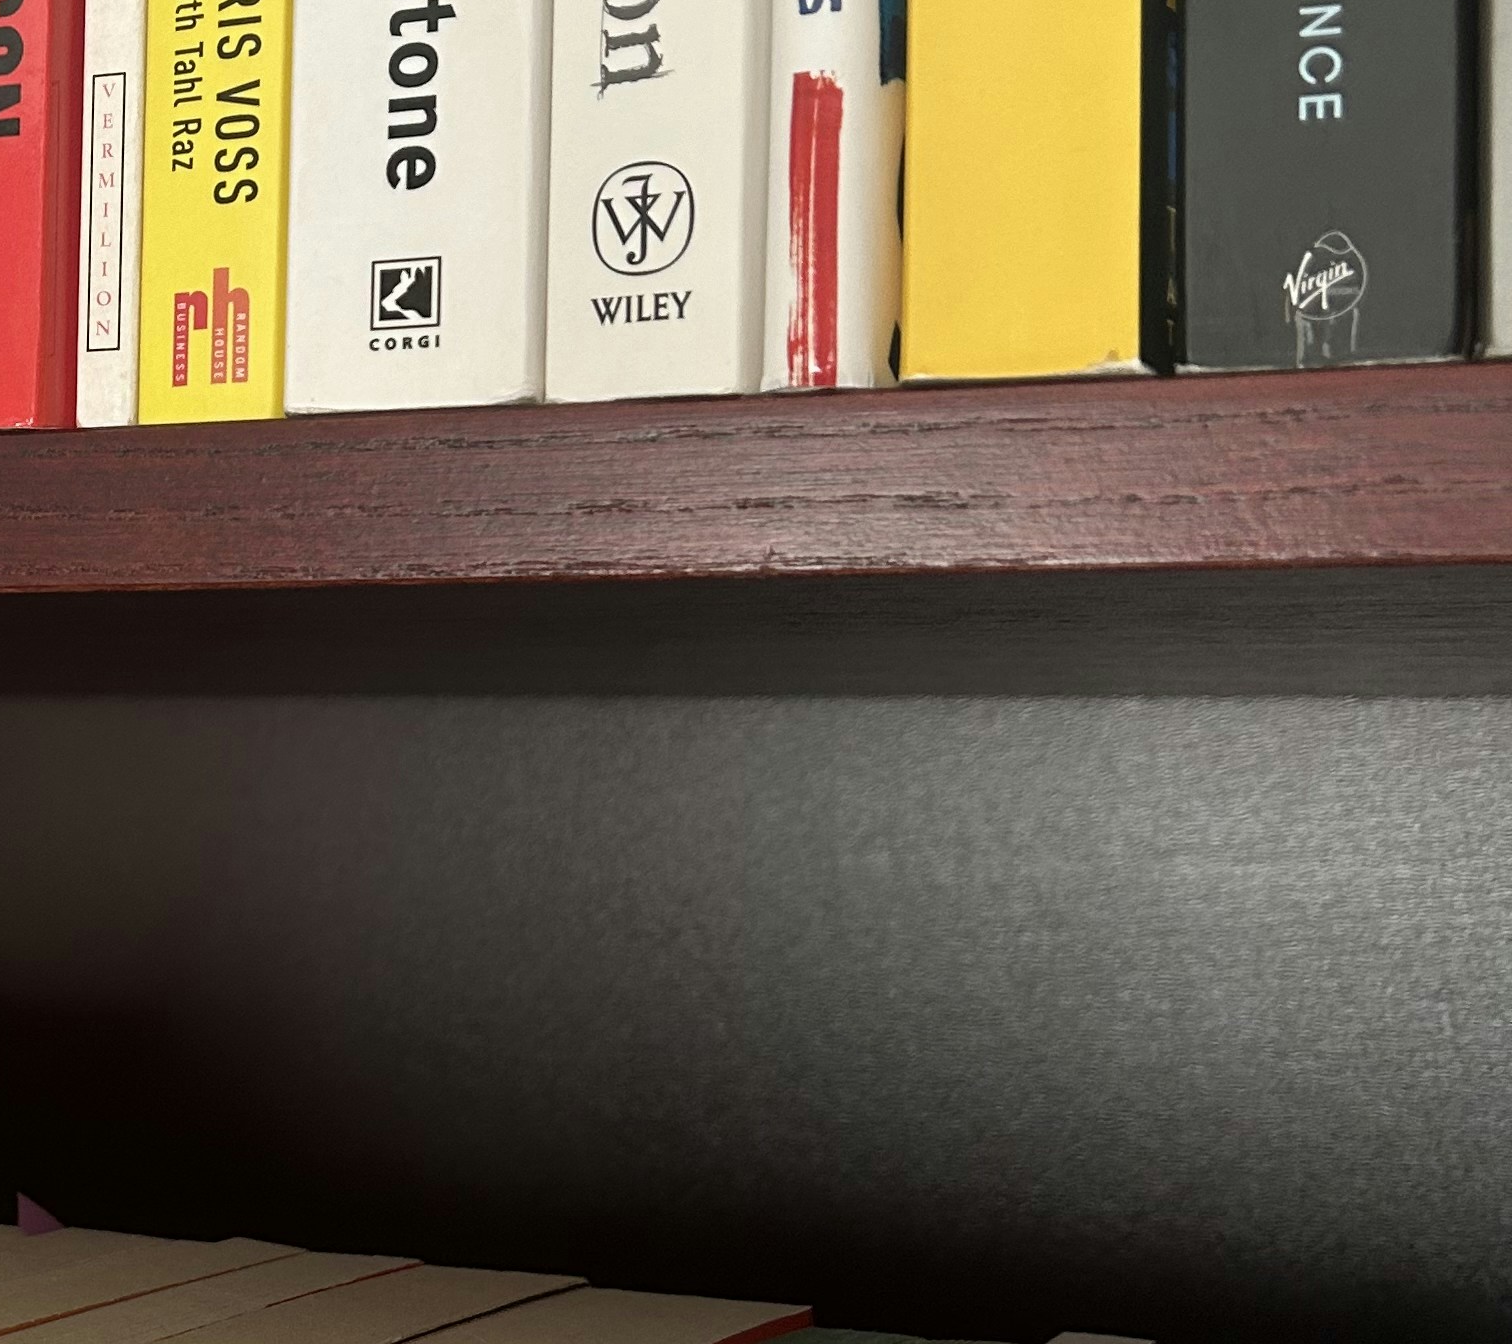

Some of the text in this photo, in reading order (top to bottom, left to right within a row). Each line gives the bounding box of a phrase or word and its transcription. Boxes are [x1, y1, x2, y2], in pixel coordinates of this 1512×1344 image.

[211, 77, 262, 205] VOSS
[95, 82, 117, 338] VERMILION
[591, 290, 693, 327] WILEY
[1283, 251, 1356, 311] Virgin
